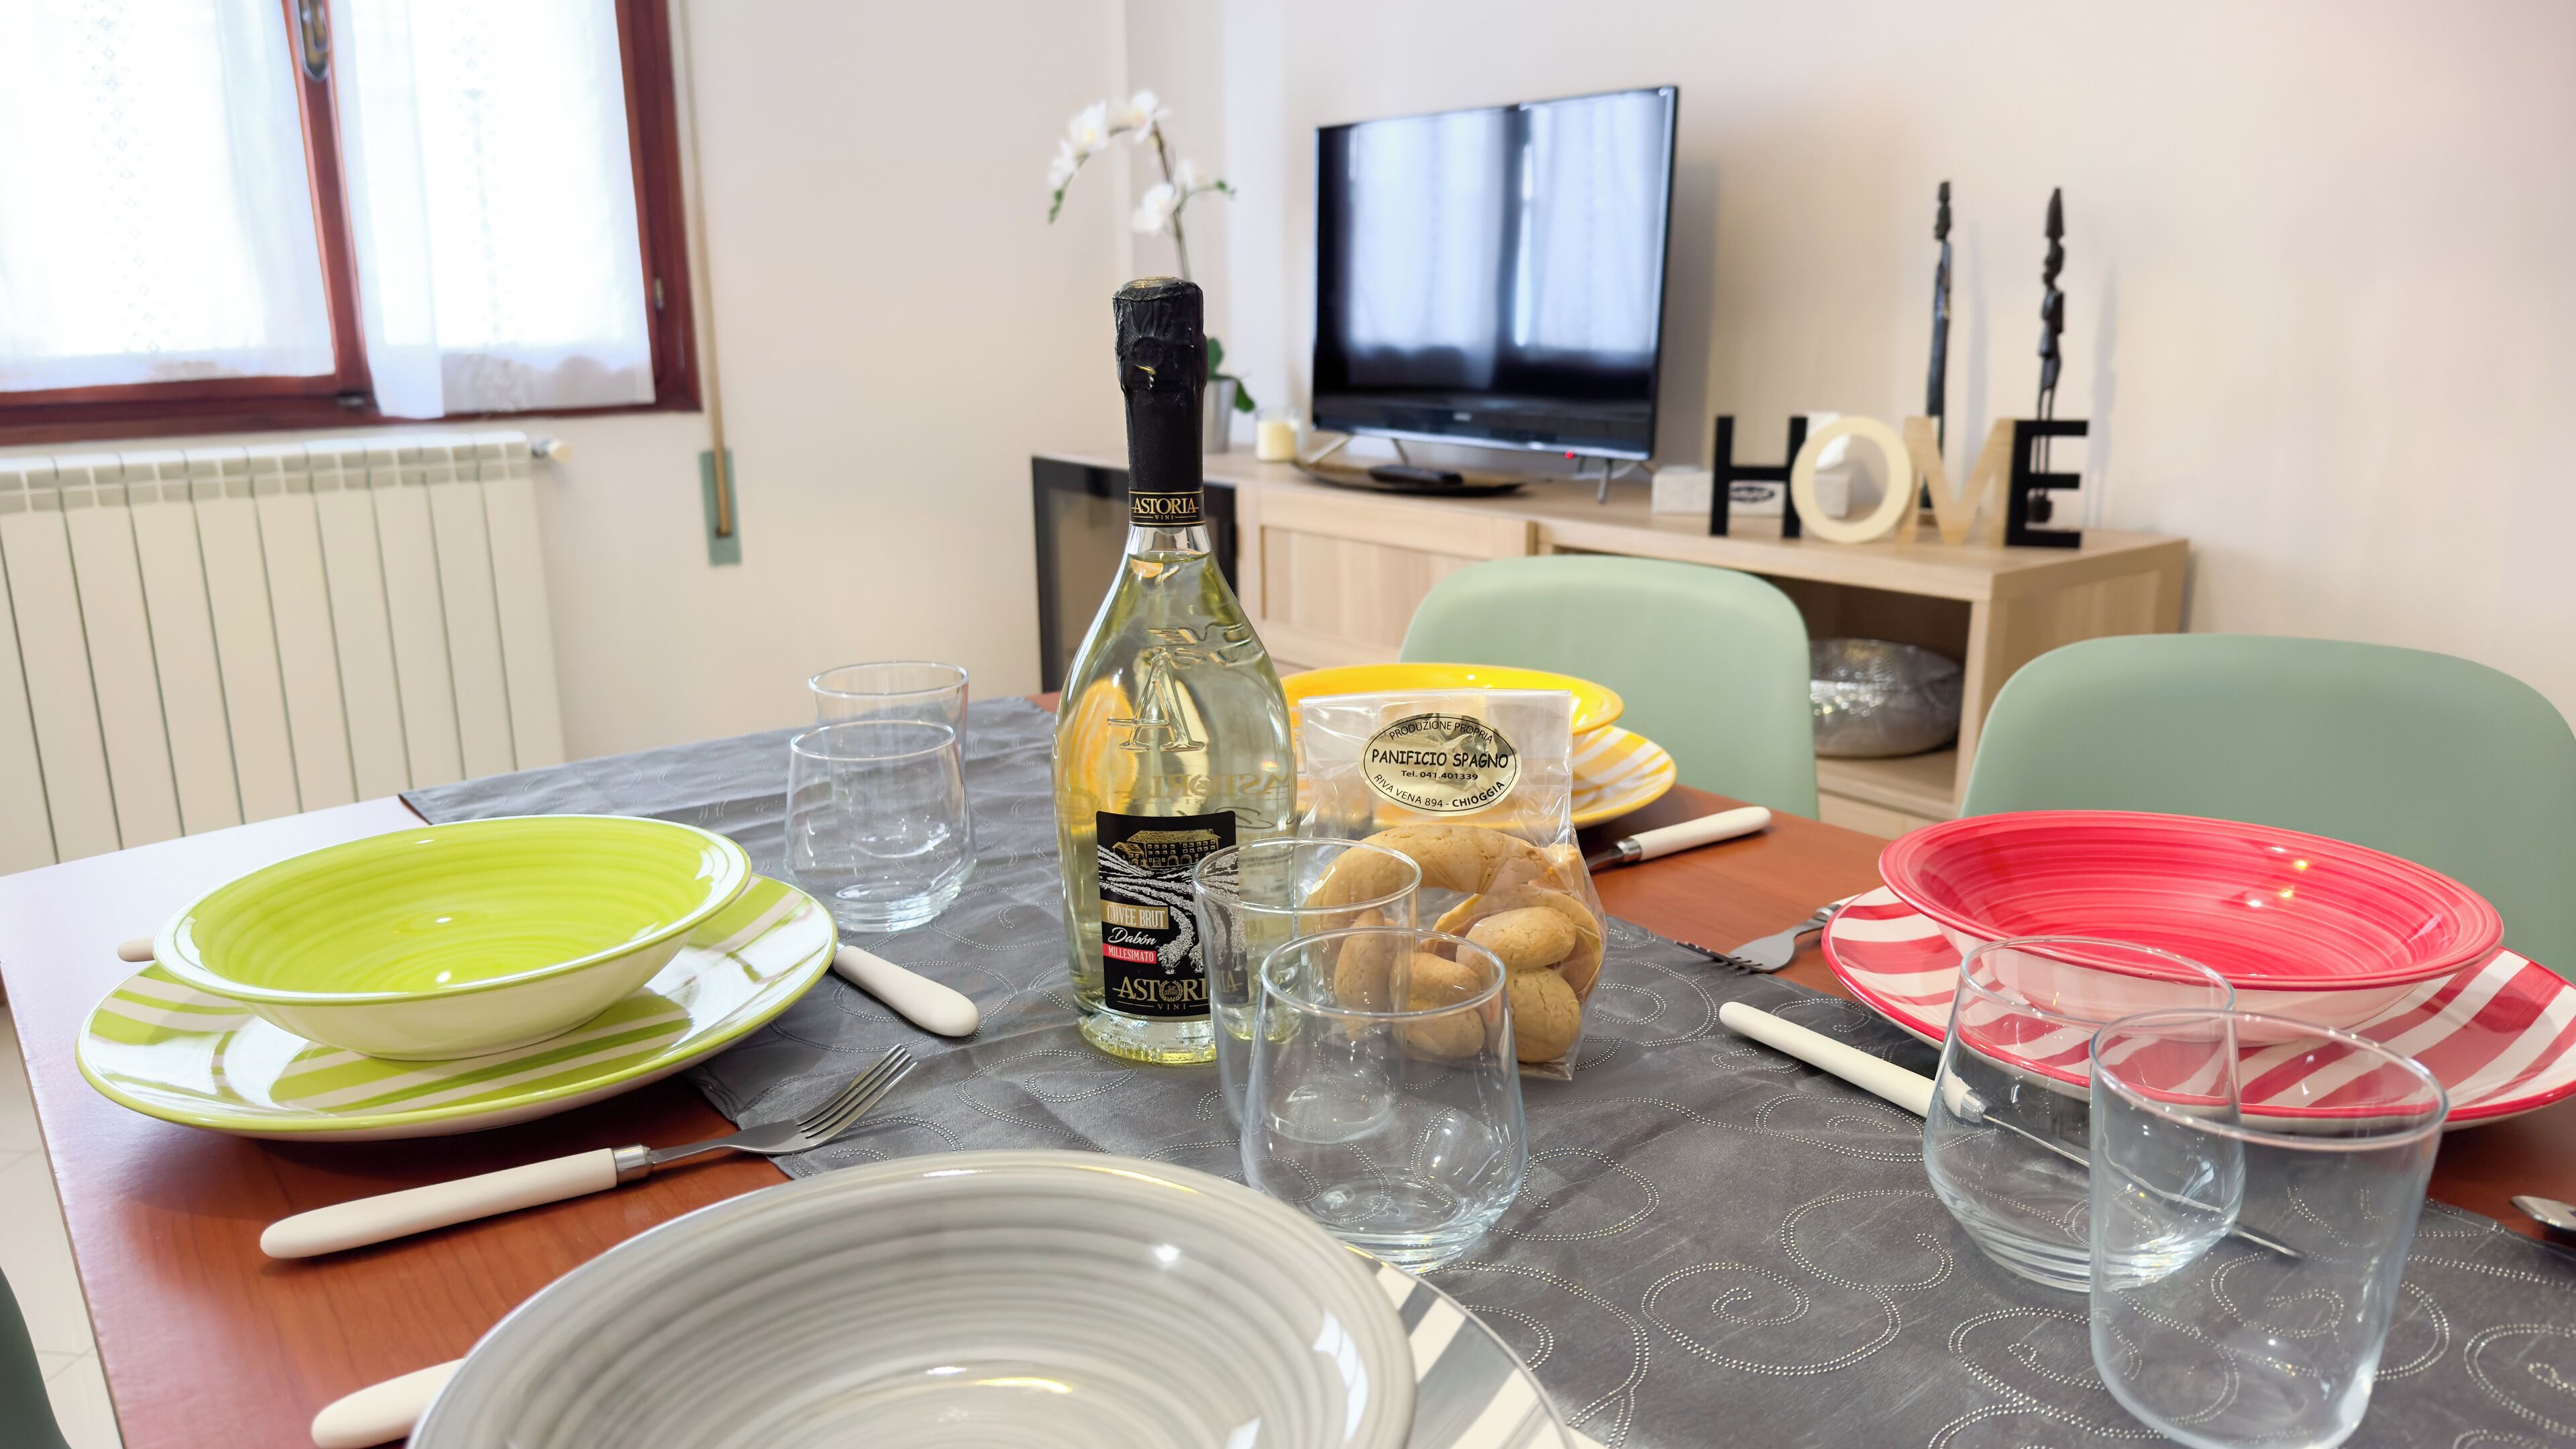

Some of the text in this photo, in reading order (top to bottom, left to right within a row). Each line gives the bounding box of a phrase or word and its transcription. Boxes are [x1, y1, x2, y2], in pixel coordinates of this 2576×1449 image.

[1709, 415, 2088, 548] HOME
[1132, 498, 1199, 515] ASTORIA
[1389, 720, 1493, 744] PRODUZIONE PROPRIA
[1371, 748, 1509, 769] PANIFICIO SPAGNO
[1401, 770, 1479, 781] Tel. 041.401339
[1373, 773, 1394, 793] RIVA
[1395, 788, 1422, 805] VENA
[1424, 798, 1443, 808] 894
[1452, 780, 1505, 808] CHIOGGIA
[1107, 905, 1166, 928] CUVÉE BRUT
[1108, 927, 1157, 947] Dabón
[1108, 947, 1155, 963] MILLESIMATO
